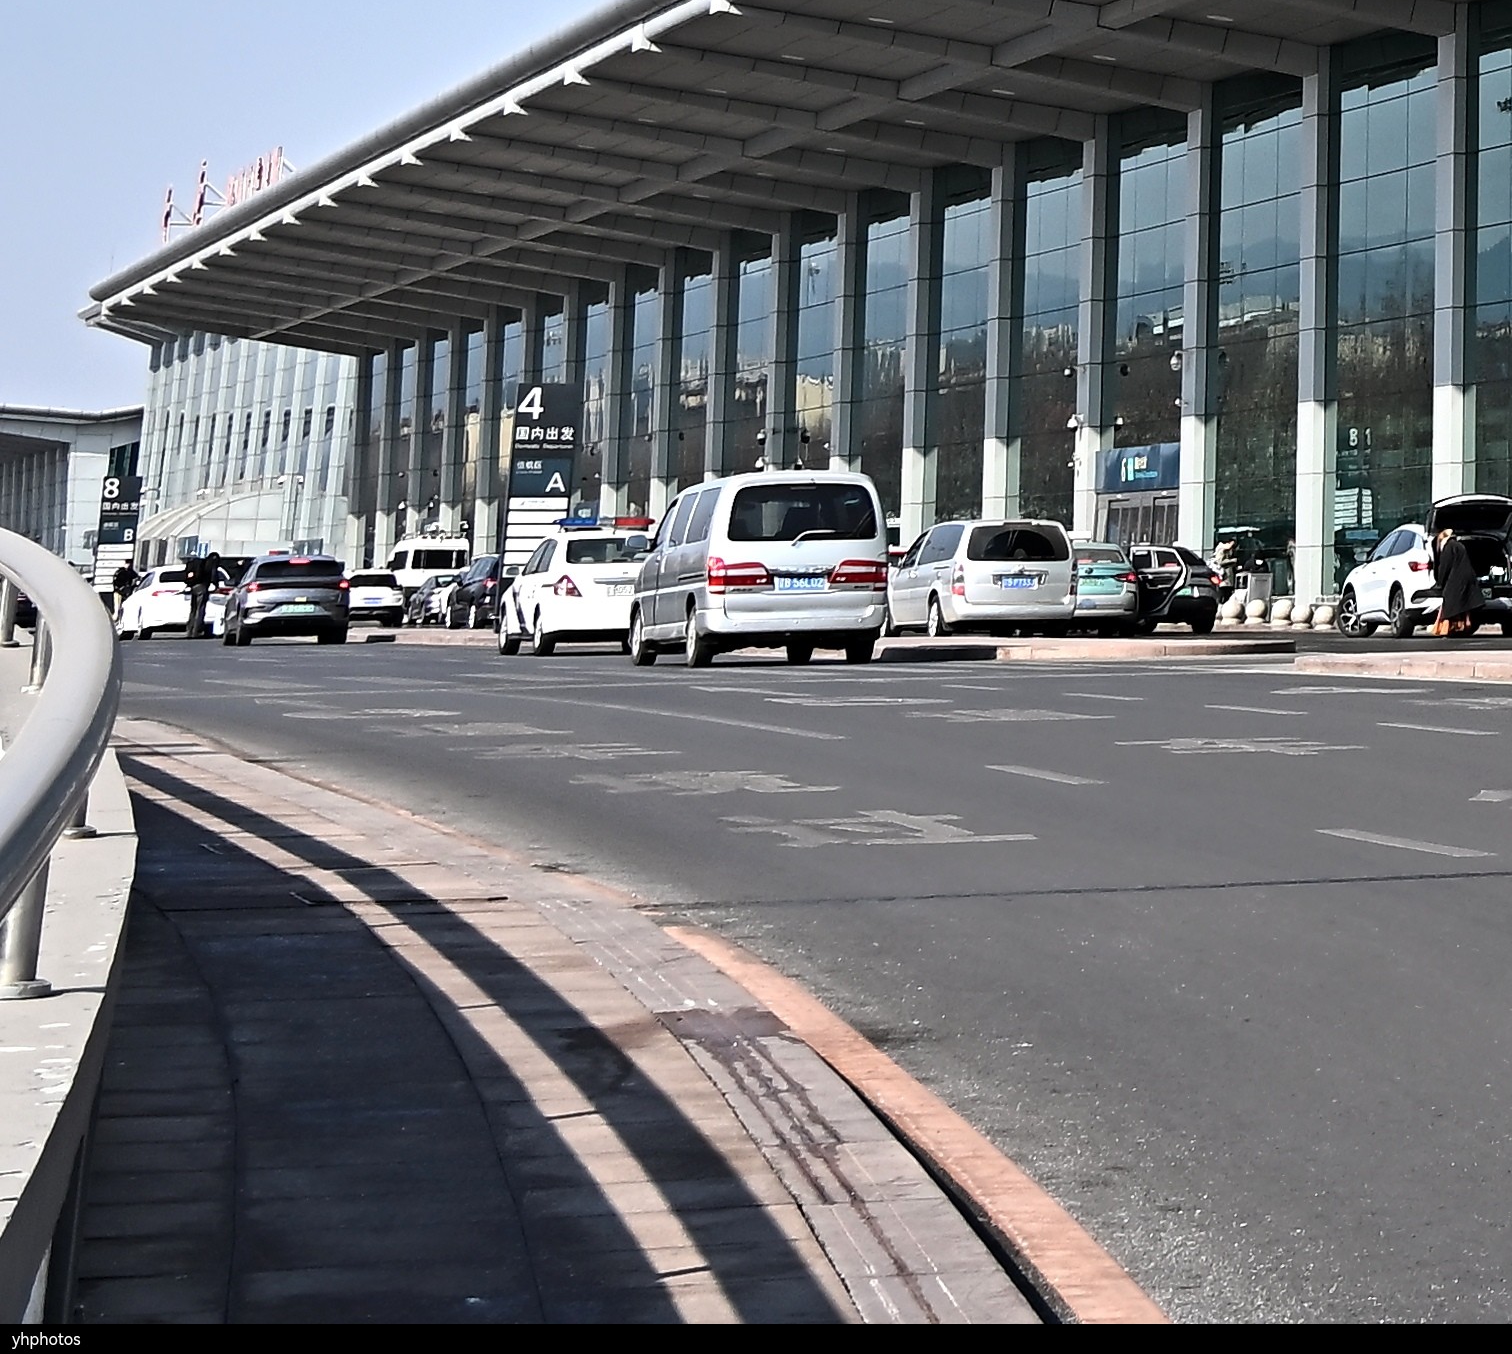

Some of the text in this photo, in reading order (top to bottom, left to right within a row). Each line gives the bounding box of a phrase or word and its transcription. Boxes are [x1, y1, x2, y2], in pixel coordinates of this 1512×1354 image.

[517, 386, 544, 420] 4
[515, 426, 575, 441] 国内出发
[104, 478, 119, 498] 8
[545, 472, 566, 492] A
[124, 529, 134, 541] B
